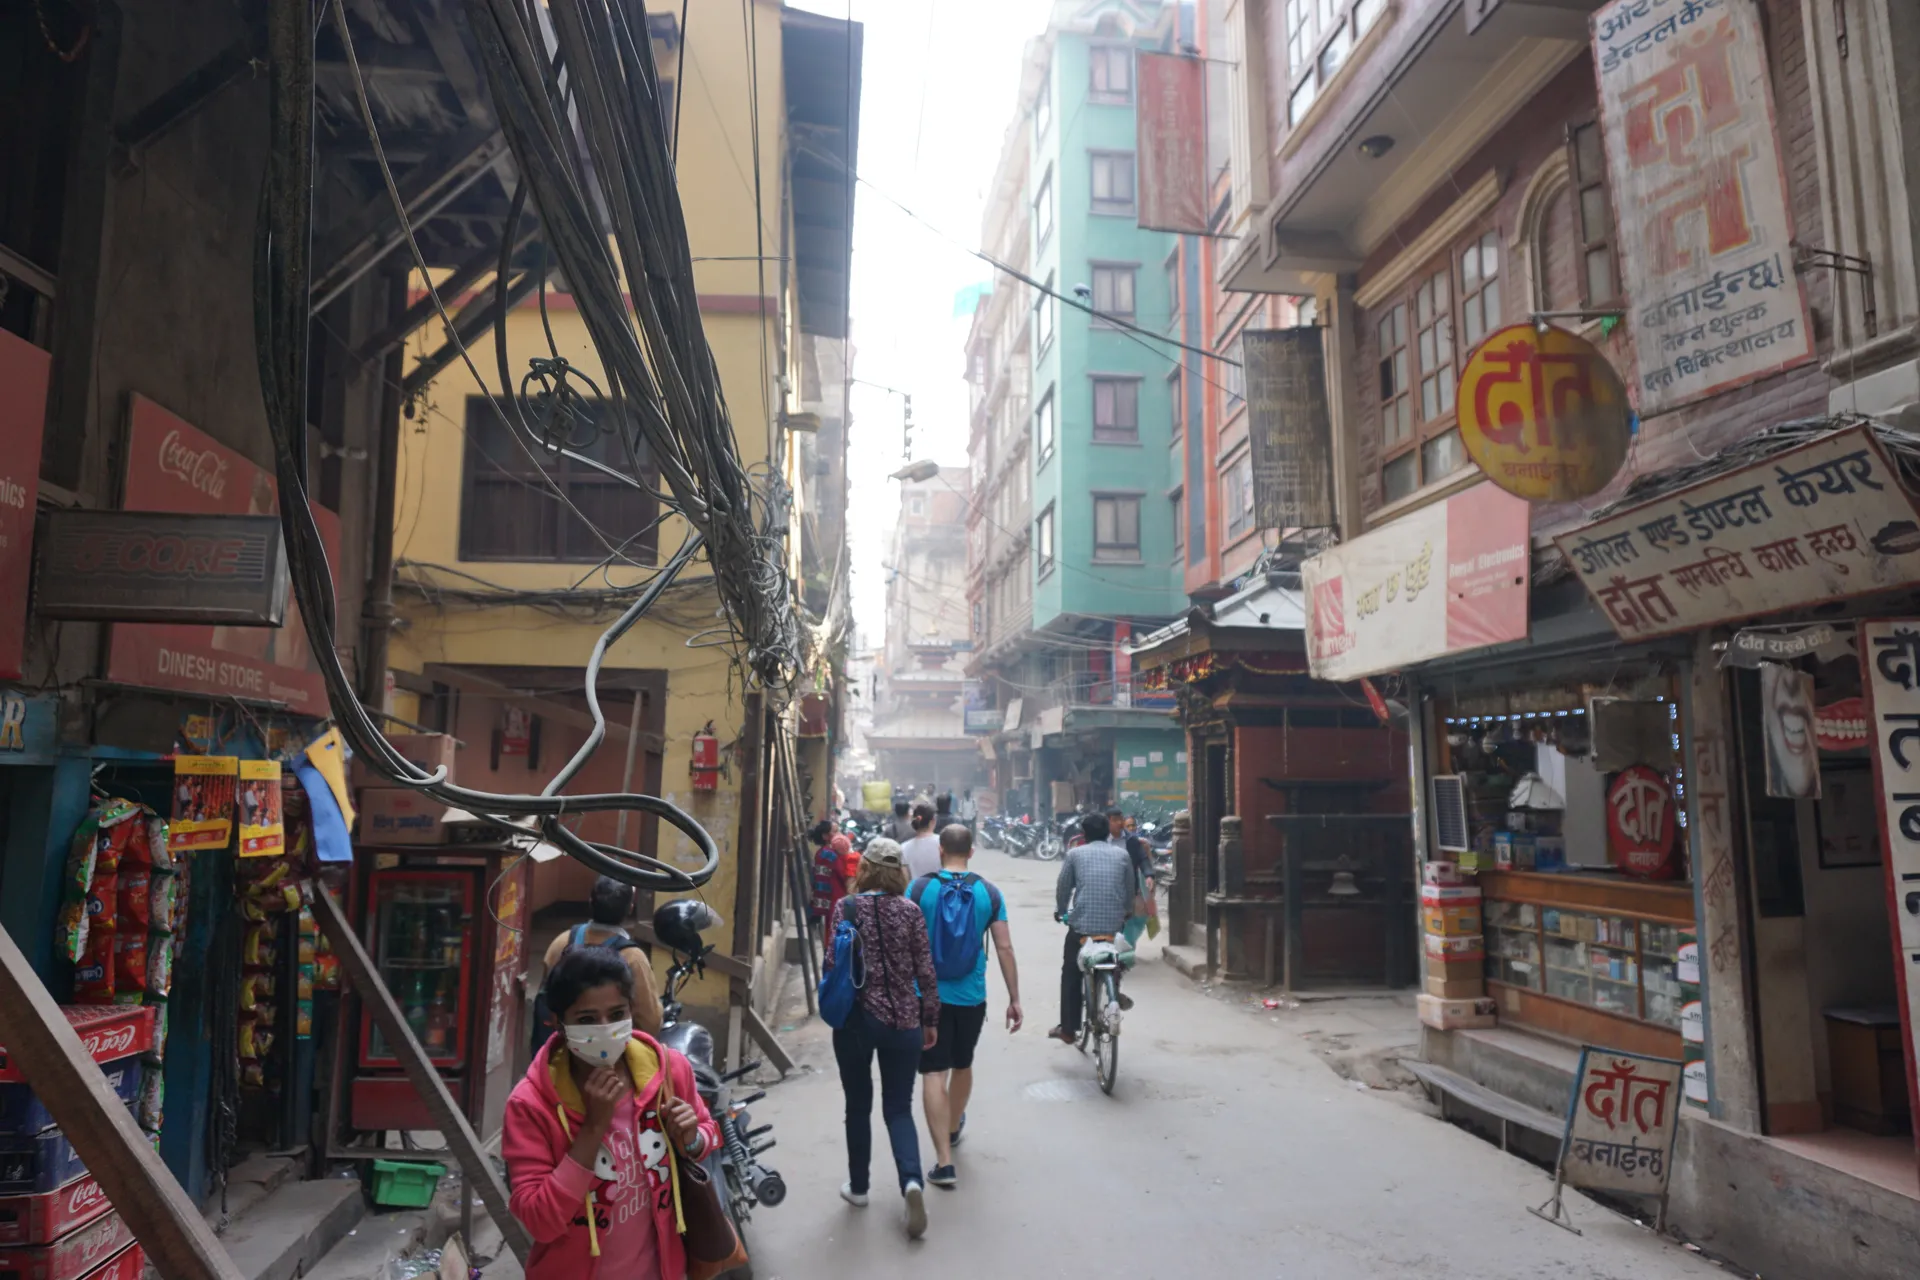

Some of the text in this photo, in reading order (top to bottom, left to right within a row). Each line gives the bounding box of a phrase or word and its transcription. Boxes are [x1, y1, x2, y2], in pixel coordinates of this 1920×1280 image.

[1474, 340, 1602, 455] दाँत
[159, 429, 230, 500] Coca-Cola
[1571, 530, 1640, 575] ओरल
[1773, 448, 1884, 507] केयर
[1597, 574, 1679, 632] दाँत
[1750, 537, 1810, 573] काम
[158, 648, 216, 682] DINESH
[219, 661, 264, 692] STORE
[1612, 768, 1668, 845] दाँत
[1584, 1058, 1671, 1134] दाँत
